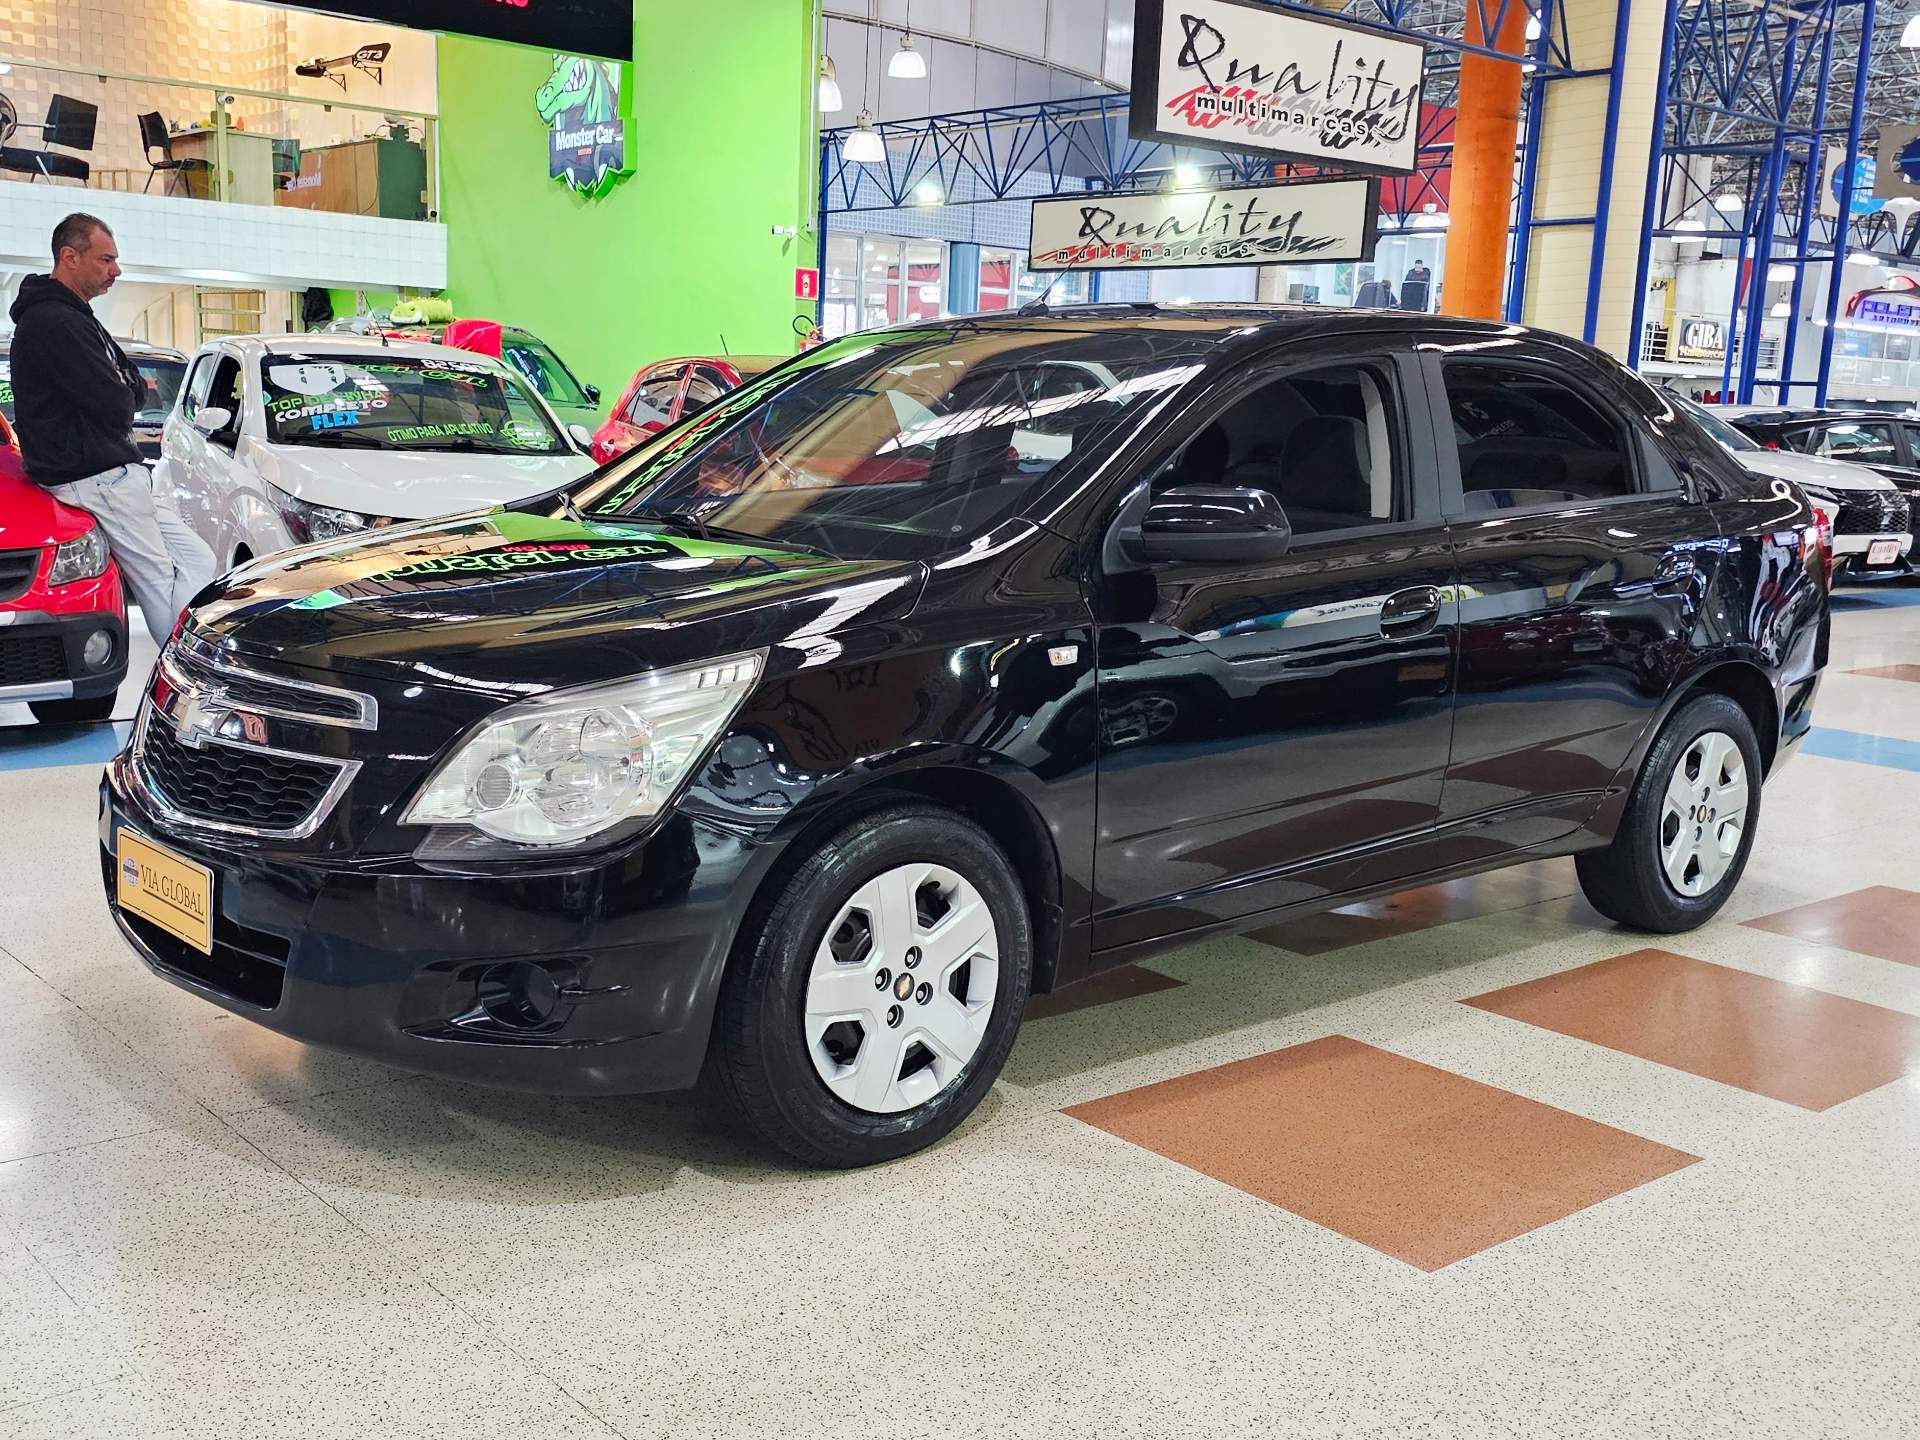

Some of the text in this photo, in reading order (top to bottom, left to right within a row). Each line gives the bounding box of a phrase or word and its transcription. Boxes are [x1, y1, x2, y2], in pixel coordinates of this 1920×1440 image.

[1178, 14, 1419, 141] Quality
[1196, 94, 1368, 137] multimarcas
[555, 125, 615, 152] Monster Car
[1078, 194, 1303, 252] Quality
[1057, 241, 1250, 260] multimarcas
[267, 398, 303, 412] TOP
[275, 399, 388, 423] COMPLETO
[311, 411, 359, 431] FLEX
[416, 425, 445, 438] PARA
[443, 422, 494, 435] APLICATIVO
[140, 864, 204, 916] VIA GLOBAL
